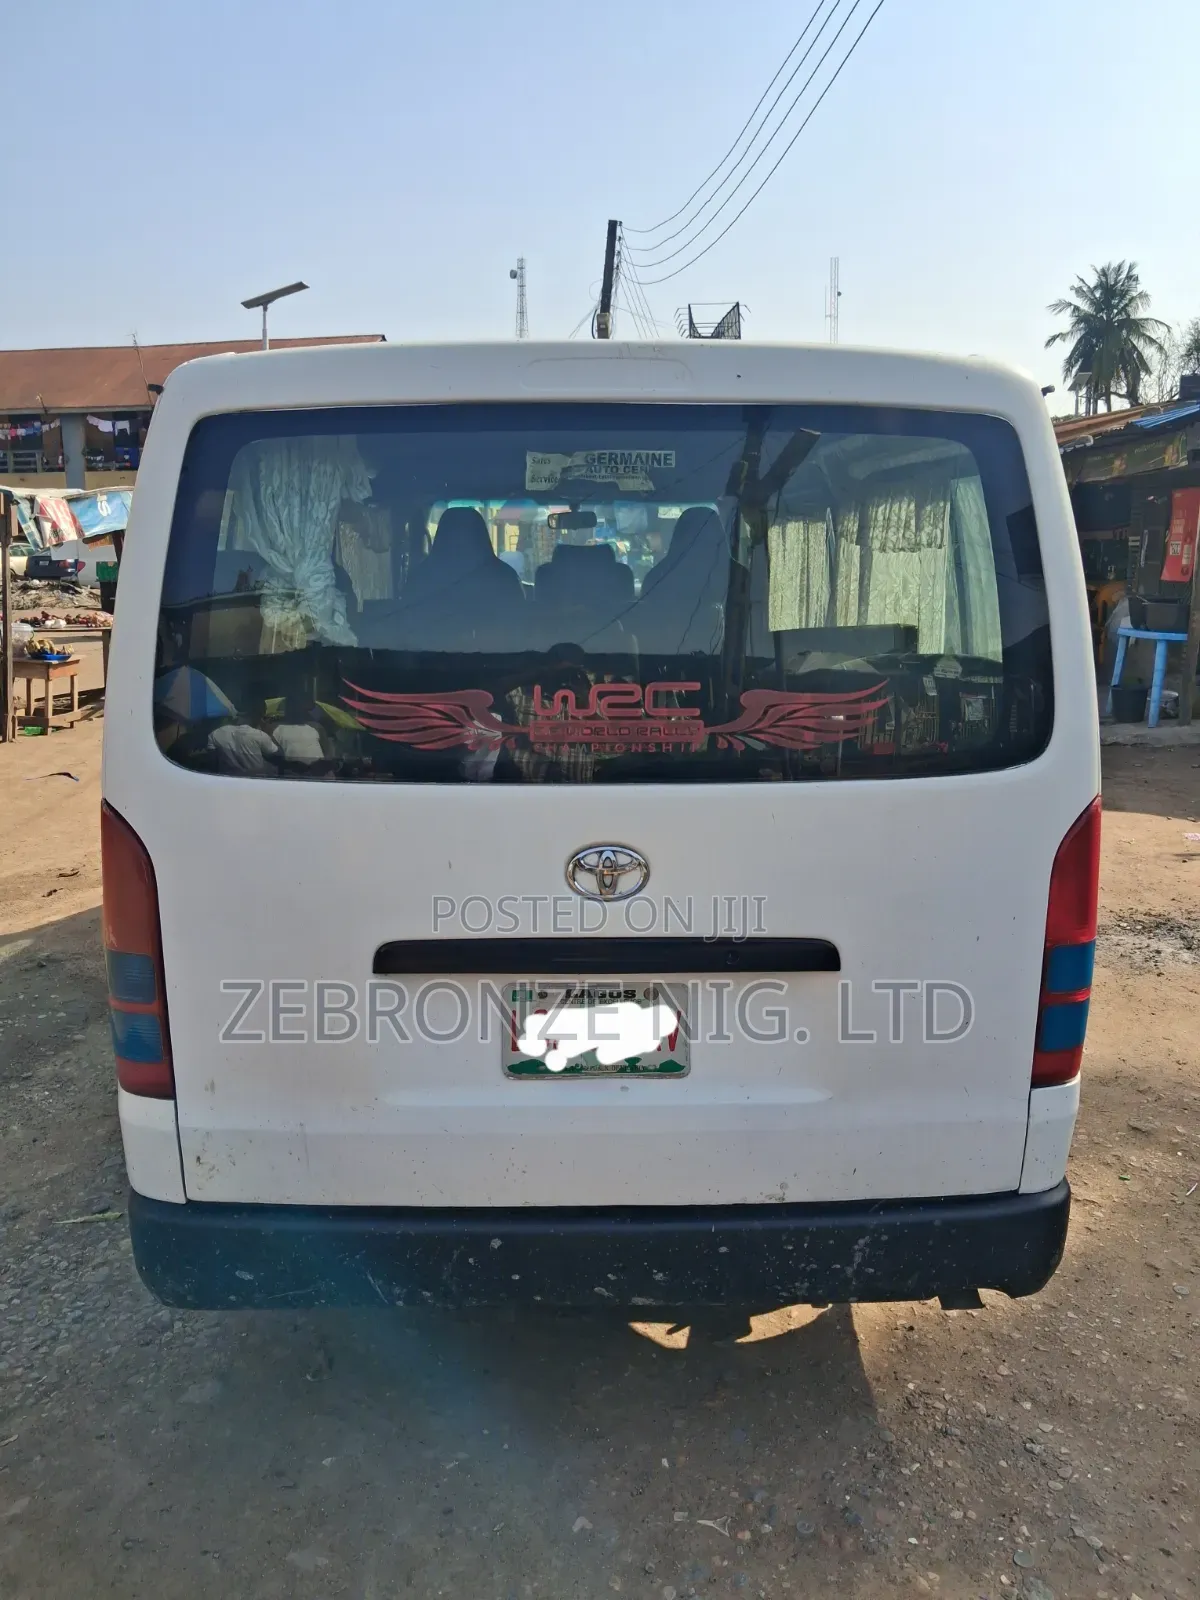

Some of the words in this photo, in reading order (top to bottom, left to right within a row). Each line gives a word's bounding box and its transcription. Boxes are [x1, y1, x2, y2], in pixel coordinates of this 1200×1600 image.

[584, 451, 674, 467] GERMAINE
[586, 465, 619, 474] AUTO
[533, 681, 702, 716] WRC
[566, 726, 631, 736] WORLD
[636, 726, 700, 736] RALLY
[564, 988, 637, 999] LAGOS
